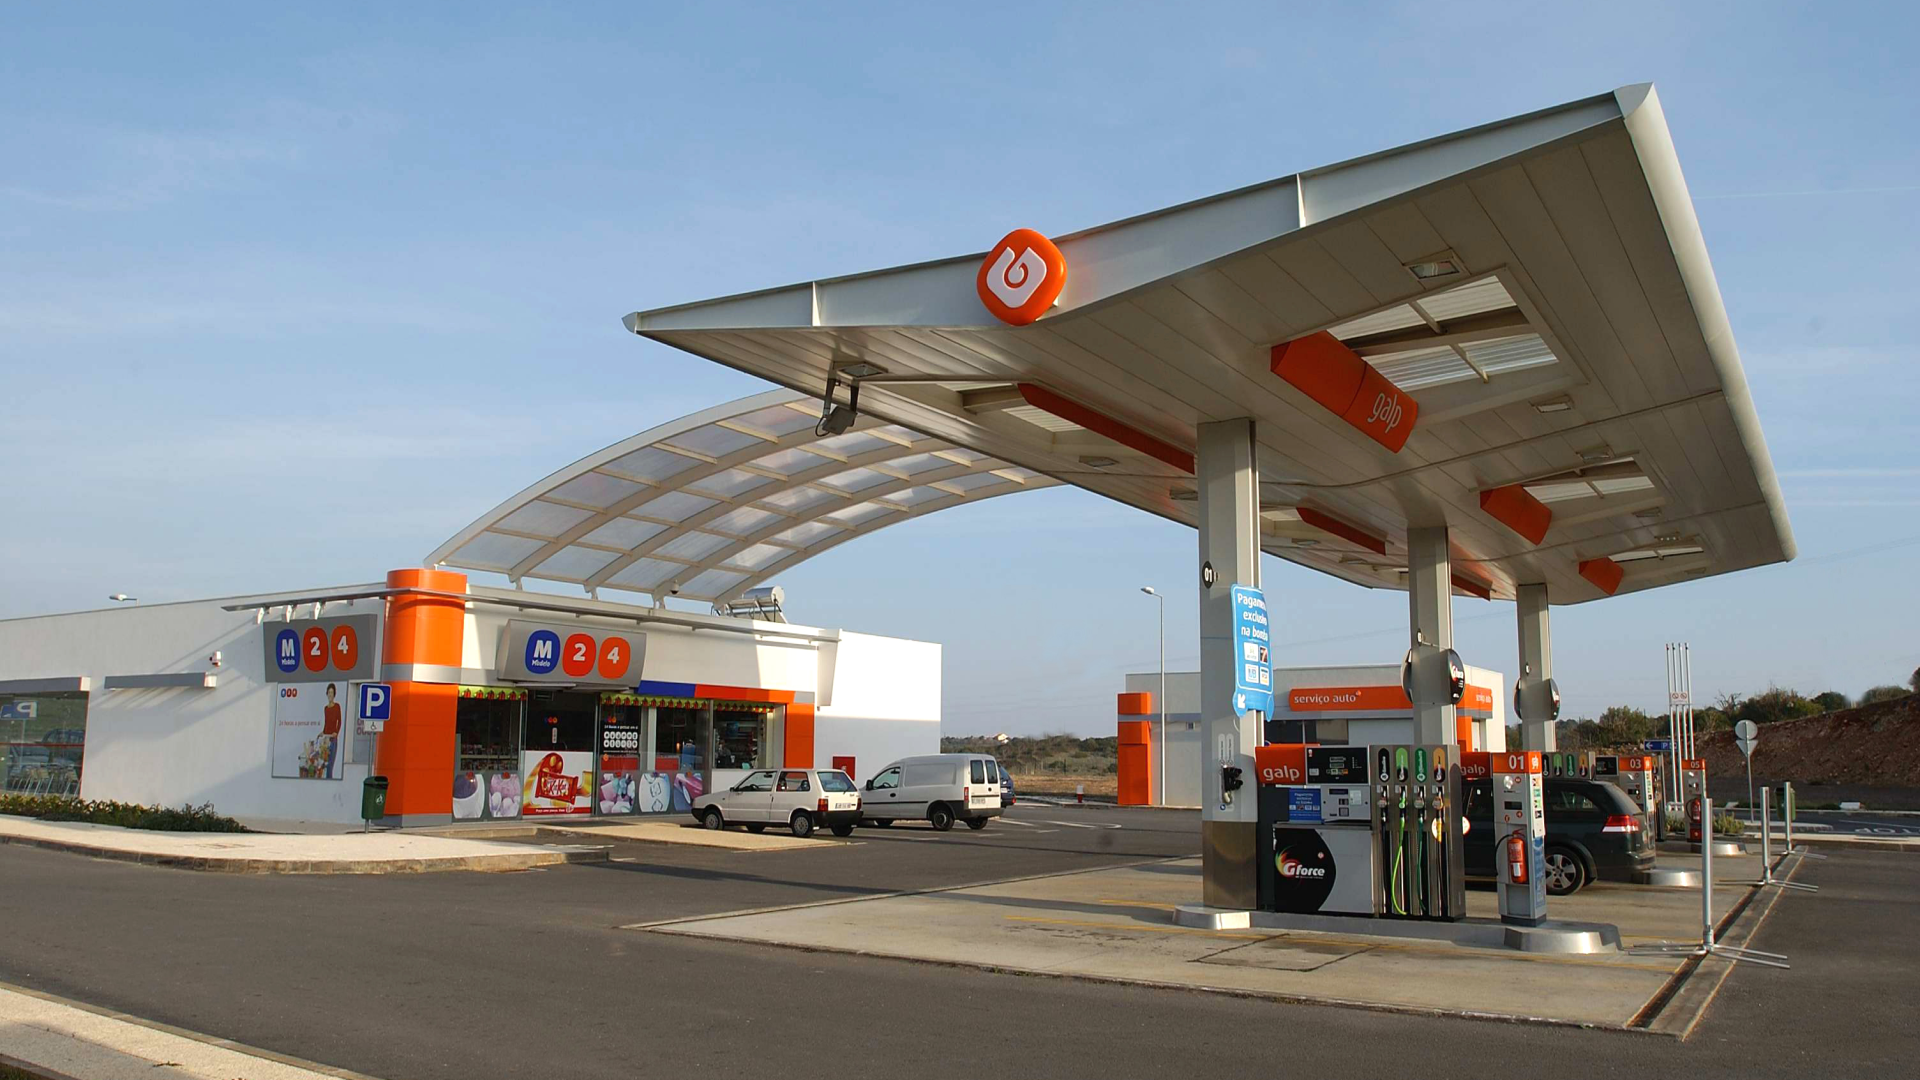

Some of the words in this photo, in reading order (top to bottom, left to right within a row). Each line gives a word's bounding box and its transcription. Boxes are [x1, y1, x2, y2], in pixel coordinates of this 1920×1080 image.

[1367, 393, 1402, 434] galp
[1204, 567, 1213, 583] 01
[1241, 626, 1251, 637] na
[366, 687, 385, 717] P
[1294, 694, 1330, 705] serviço
[1332, 693, 1357, 703] auto
[1508, 754, 1524, 770] 01
[1629, 758, 1642, 769] 03
[1690, 760, 1700, 769] 05
[1263, 765, 1300, 781] galp
[1460, 763, 1486, 776] galp
